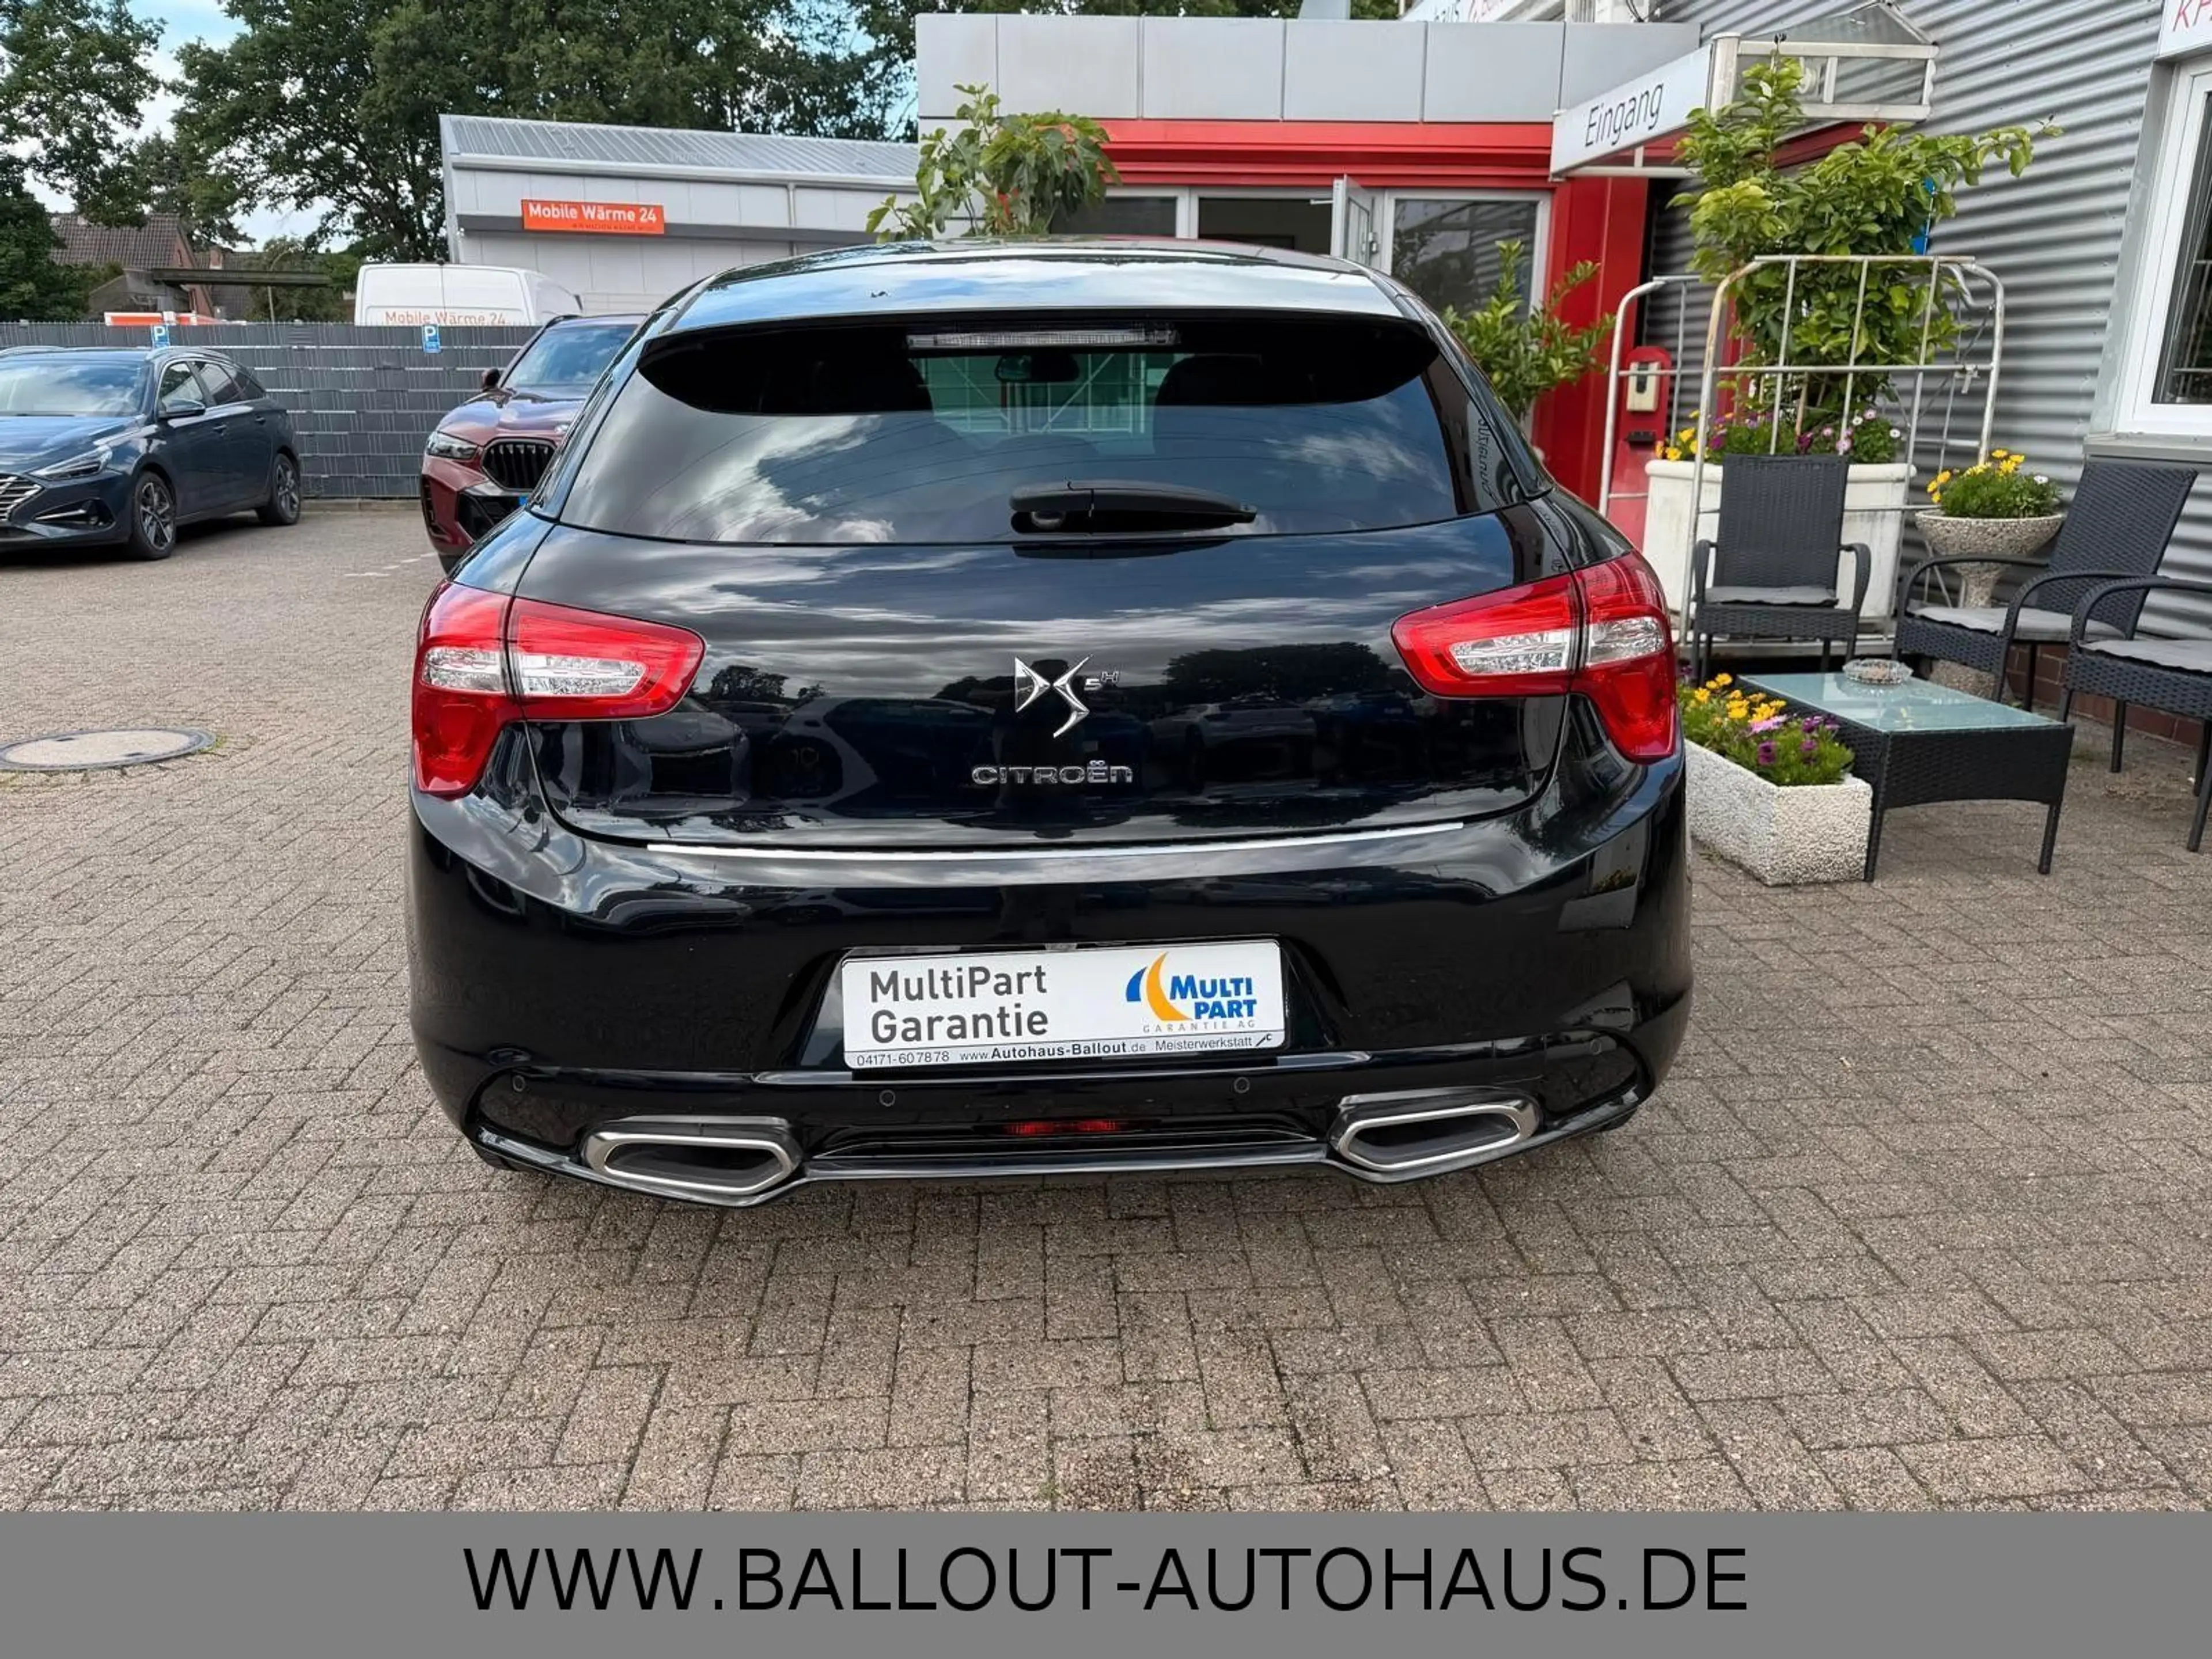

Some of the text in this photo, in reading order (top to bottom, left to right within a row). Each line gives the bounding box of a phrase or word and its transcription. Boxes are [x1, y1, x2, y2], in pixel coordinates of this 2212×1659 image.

[1585, 83, 1664, 147] Eingang
[528, 202, 657, 224] Mobile Wärme 24
[385, 310, 506, 325] Mobile Wärme 24
[154, 325, 165, 341] P
[425, 326, 436, 342] P
[971, 760, 1134, 785] CITROËN
[870, 965, 1047, 1003] MultiPart
[1169, 975, 1253, 1000] MULTI
[1194, 999, 1257, 1020] PART
[872, 1003, 1048, 1043] Garantie
[1143, 1020, 1256, 1033] GARANTIE AG
[857, 1036, 1252, 1066] 04171-607878 www.Autohaus-Ballout.de Meisterwerkstatt
